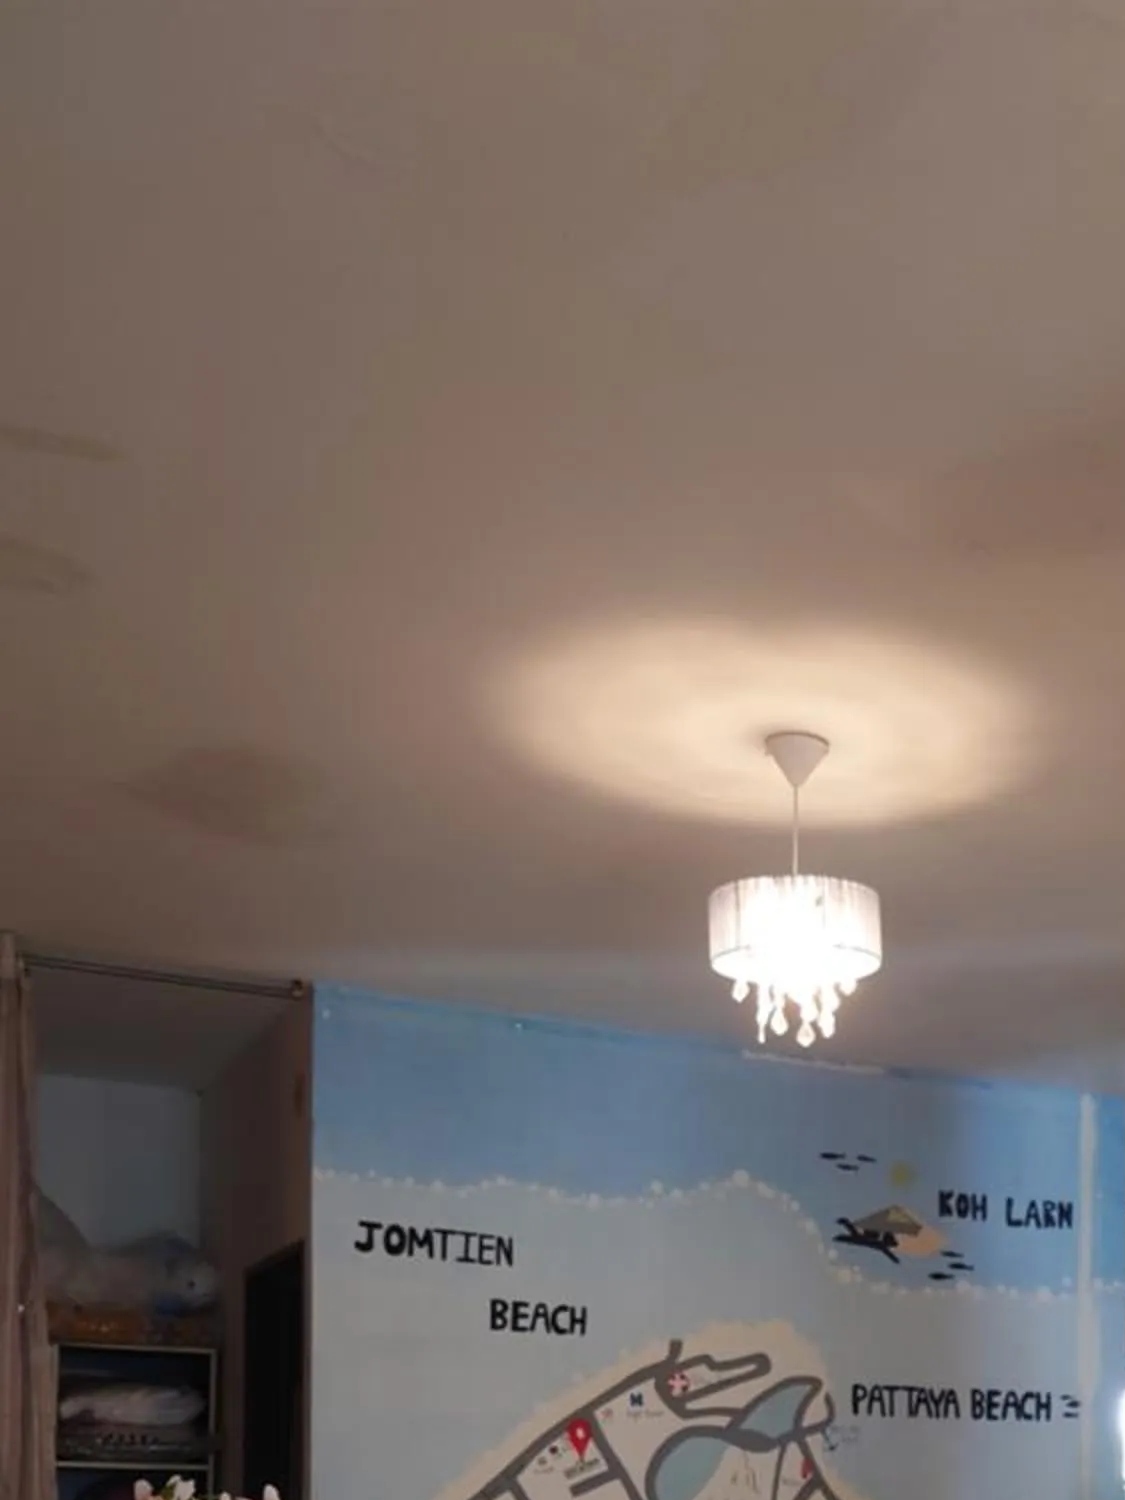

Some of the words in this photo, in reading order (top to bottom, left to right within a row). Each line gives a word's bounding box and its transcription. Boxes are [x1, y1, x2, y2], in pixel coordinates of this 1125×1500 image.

[938, 1190, 988, 1222] KOH
[1005, 1198, 1073, 1230] LARN
[354, 1220, 514, 1267] JOMTIEN
[489, 1299, 588, 1336] BEACH
[851, 1383, 961, 1420] PATTAYA
[971, 1388, 1052, 1422] BEACH
